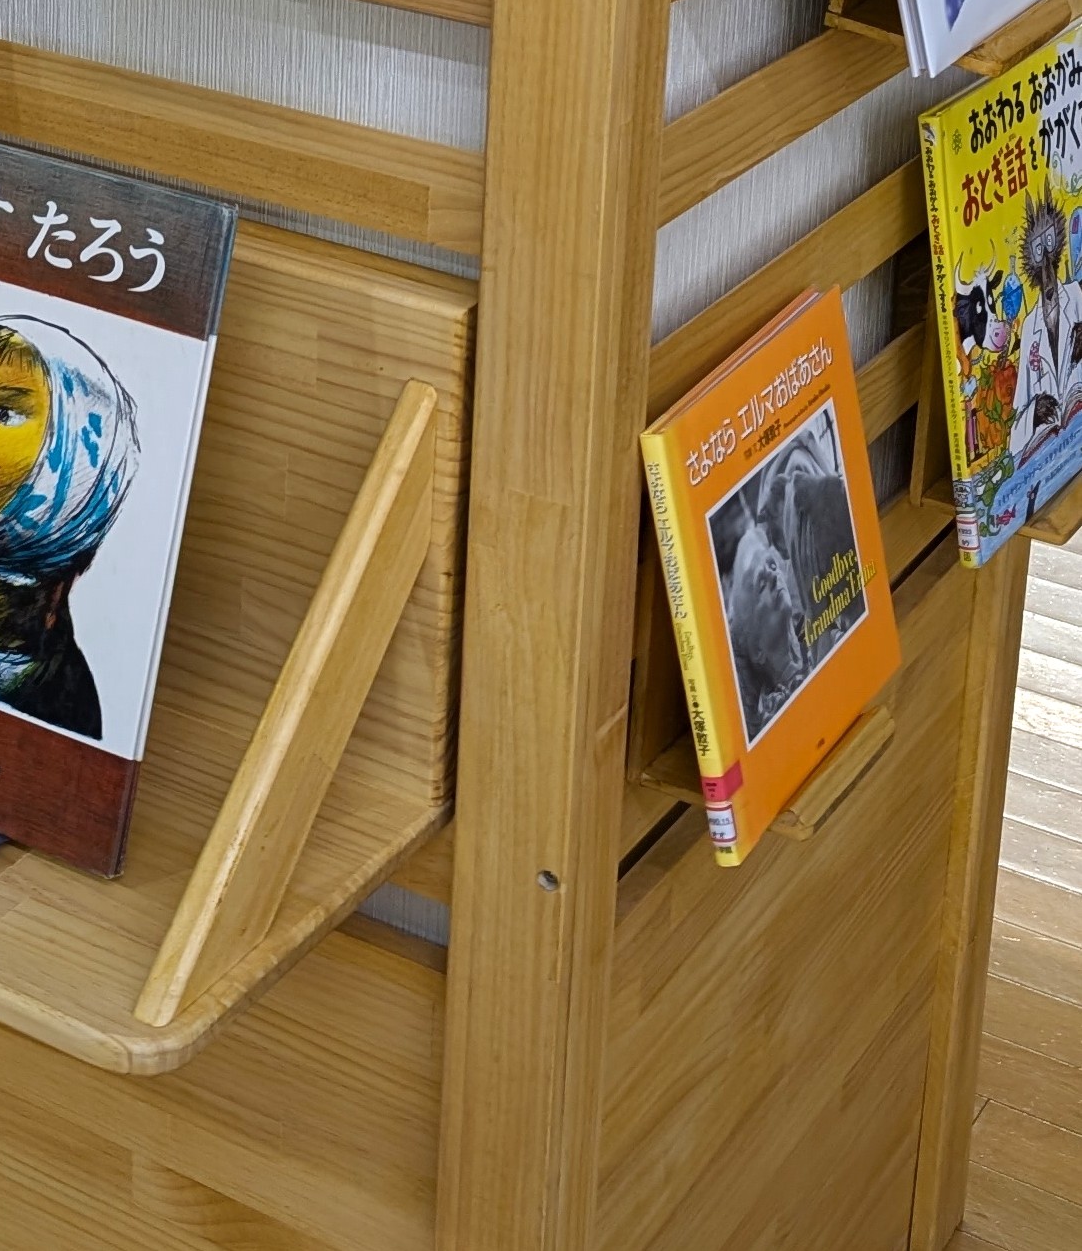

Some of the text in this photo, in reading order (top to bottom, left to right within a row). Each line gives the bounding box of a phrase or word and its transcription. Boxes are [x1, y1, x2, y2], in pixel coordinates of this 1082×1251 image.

[968, 48, 1082, 154] おおわる おおかみ
[962, 100, 1082, 228] おとぎ話をかがく
[27, 201, 169, 294] たろう
[686, 418, 738, 486] さよなら
[738, 337, 833, 440] エルマおばあさん
[804, 588, 851, 647] Grandma
[812, 549, 858, 604] Goodbye,
